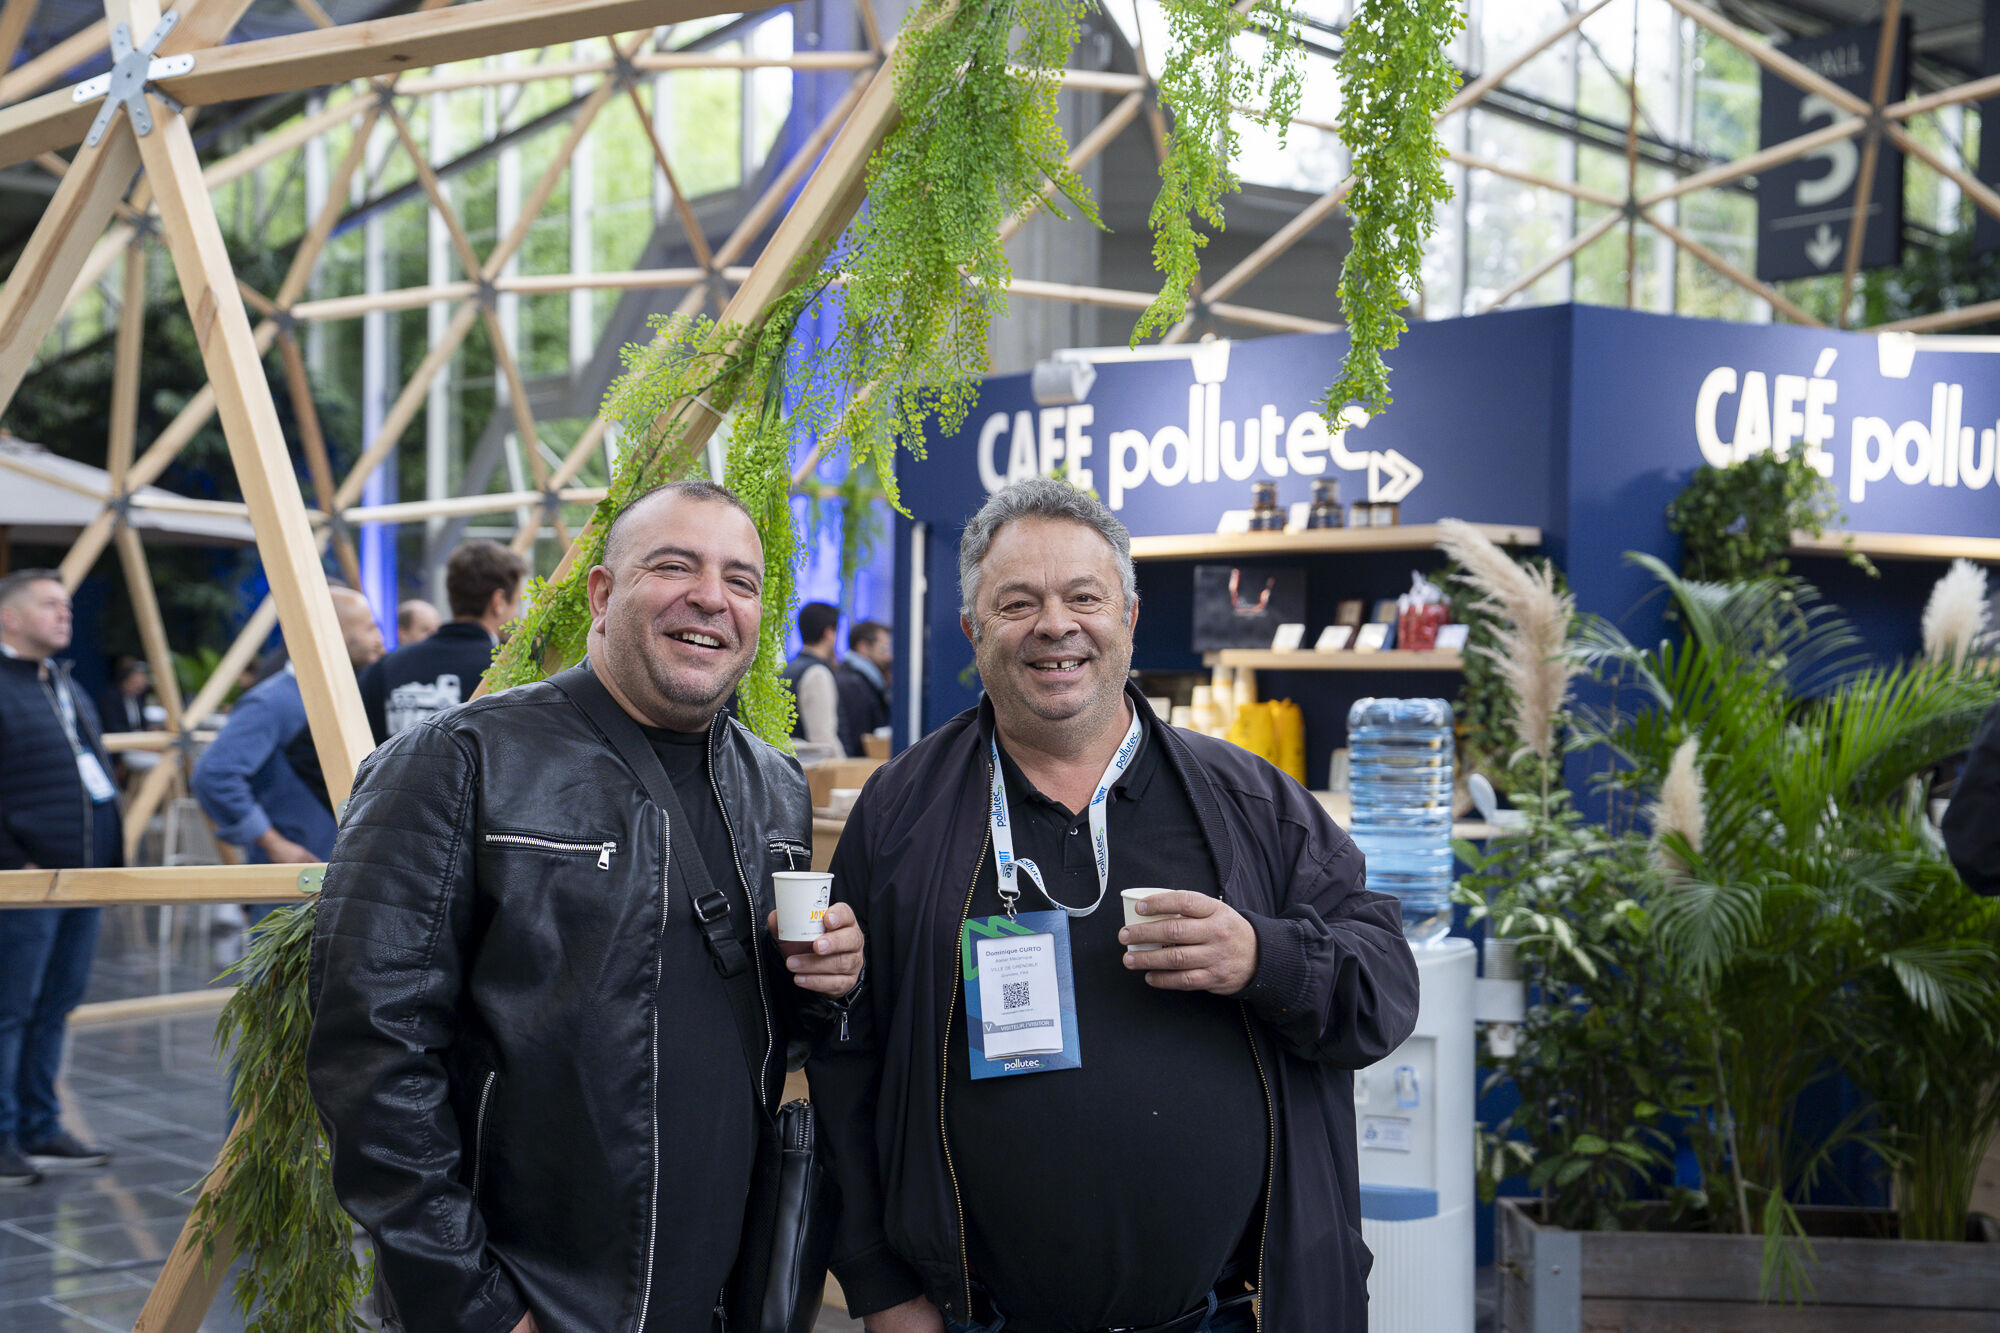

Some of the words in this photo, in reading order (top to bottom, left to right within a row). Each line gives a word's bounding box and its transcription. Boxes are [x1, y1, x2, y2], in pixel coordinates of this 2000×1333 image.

[1795, 94, 1860, 207] 3
[1695, 348, 1838, 479] CAFÉ
[1849, 382, 2000, 503] pollu
[1109, 383, 1371, 510] pollutec
[1115, 732, 1139, 770] pollutec
[991, 791, 1007, 827] pollutec
[986, 948, 1018, 957] Dominique
[984, 1023, 992, 1032] V
[1004, 1058, 1040, 1071] pollutec
